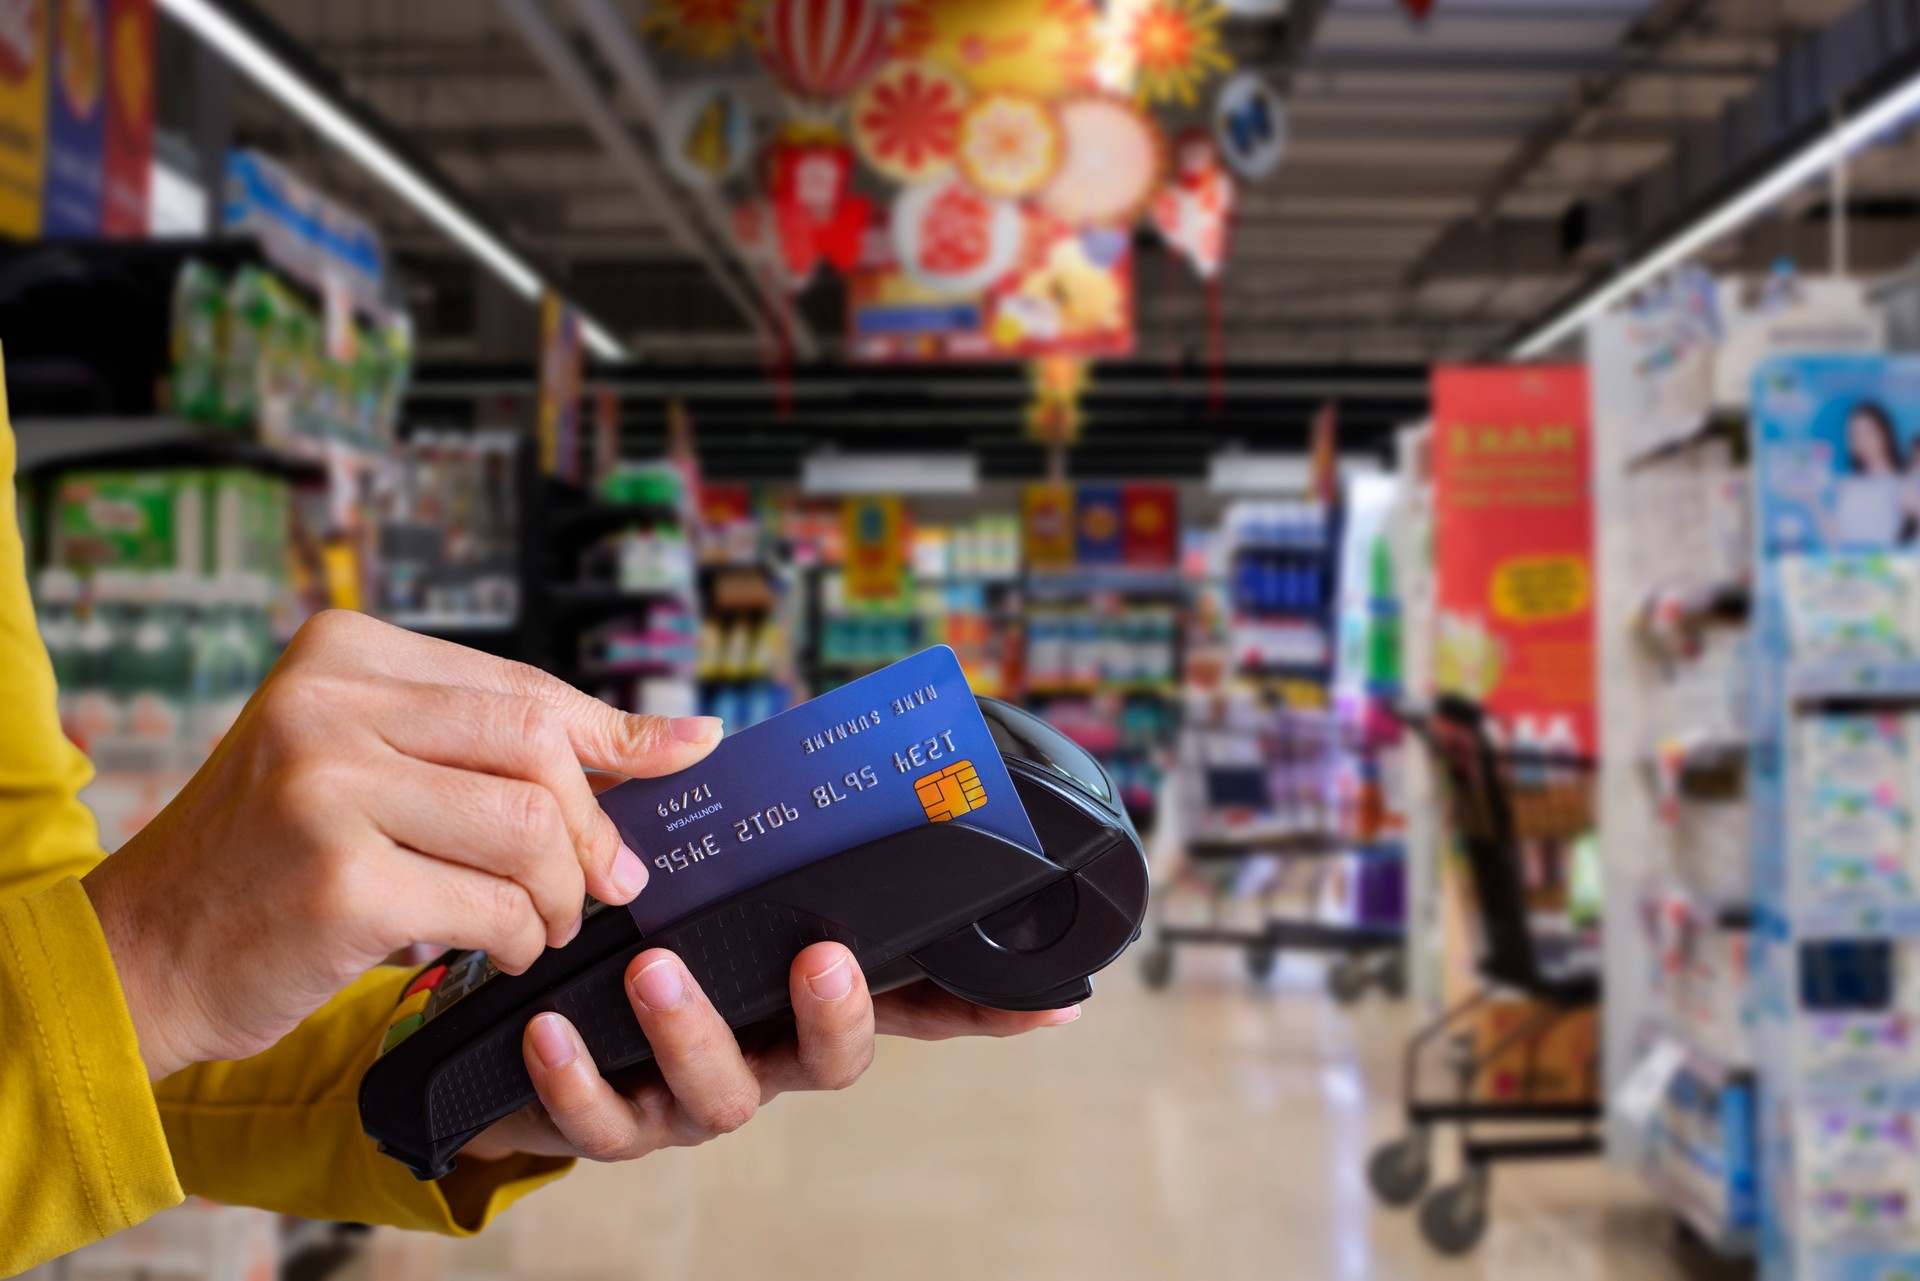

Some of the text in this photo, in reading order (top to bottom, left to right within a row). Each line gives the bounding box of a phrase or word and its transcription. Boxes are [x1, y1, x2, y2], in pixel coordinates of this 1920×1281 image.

[800, 684, 938, 755] NAME SURNAME
[654, 729, 956, 874] 1234 5678 9012 3456
[656, 783, 712, 818] 12/99
[666, 802, 723, 832] MONTH/YEAR
